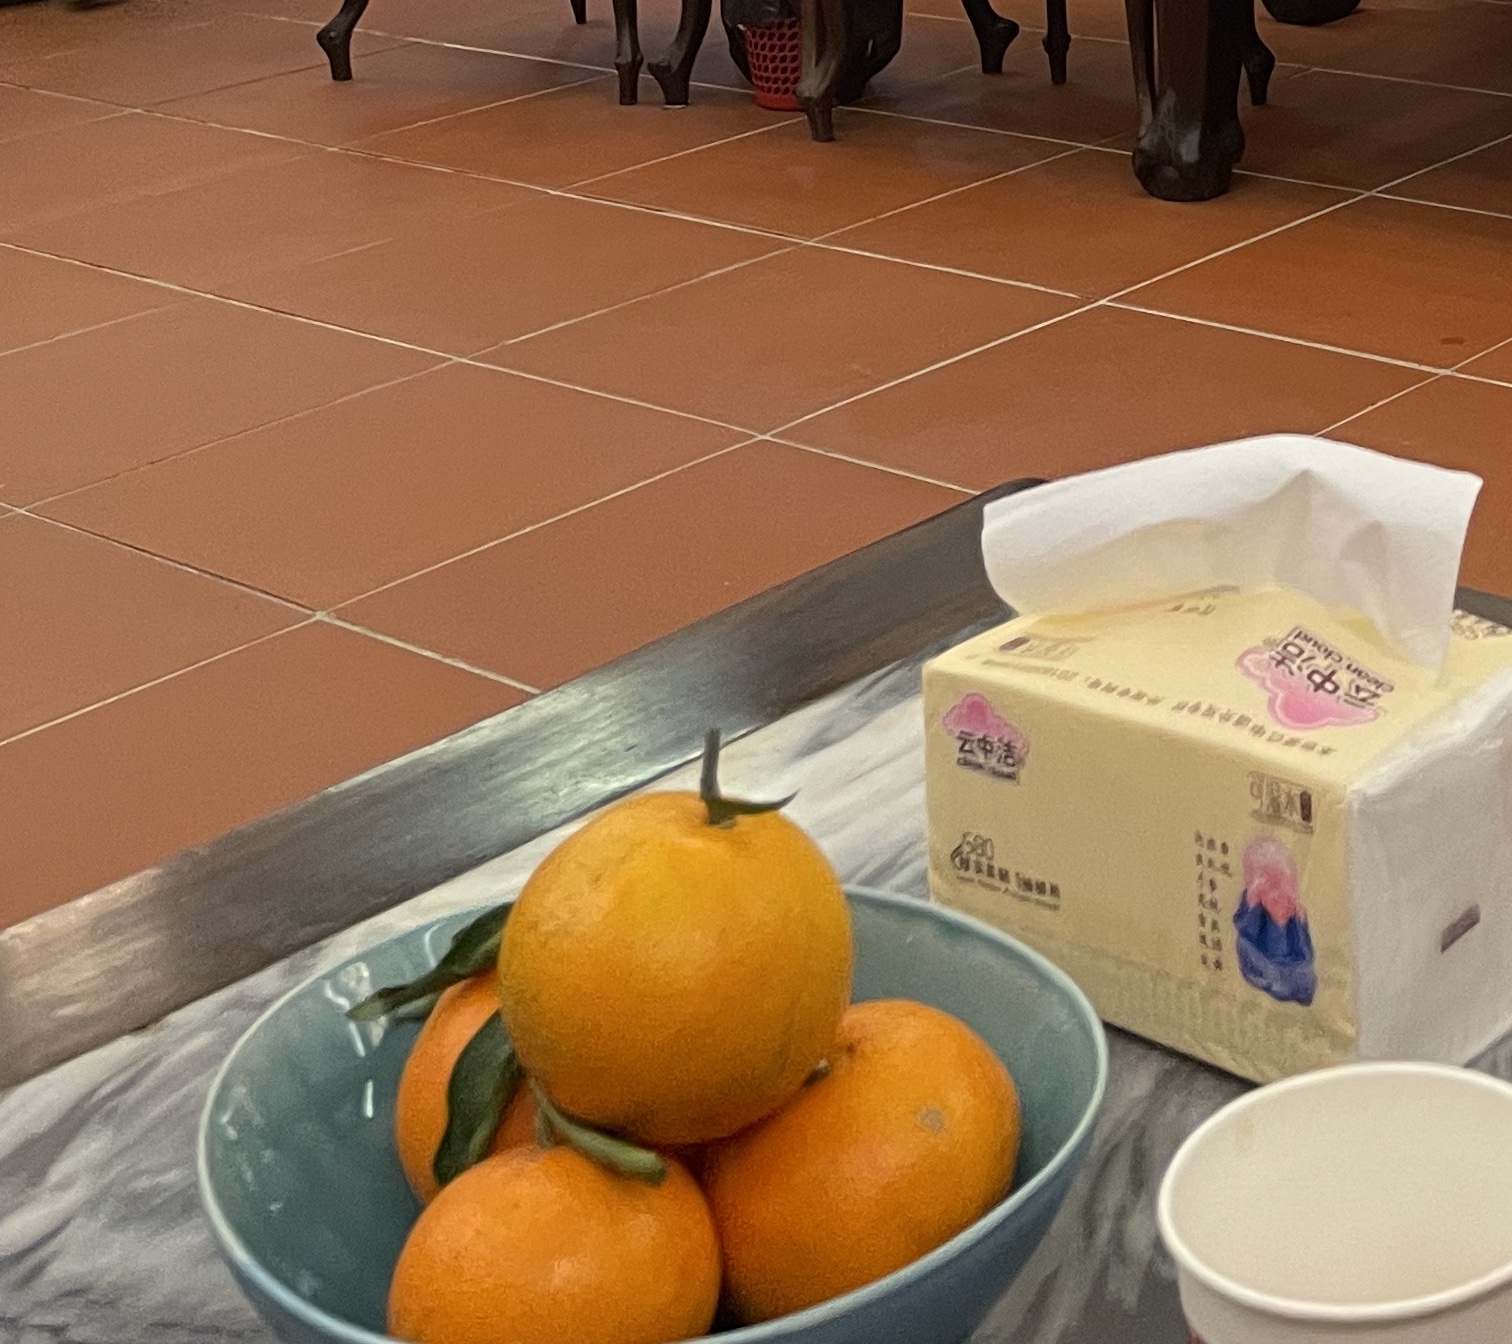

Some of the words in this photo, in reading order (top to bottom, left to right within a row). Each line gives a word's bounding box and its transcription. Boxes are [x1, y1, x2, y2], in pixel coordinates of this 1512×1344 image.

[1269, 641, 1381, 708] 云中洁
[956, 730, 1018, 767] 云中洁
